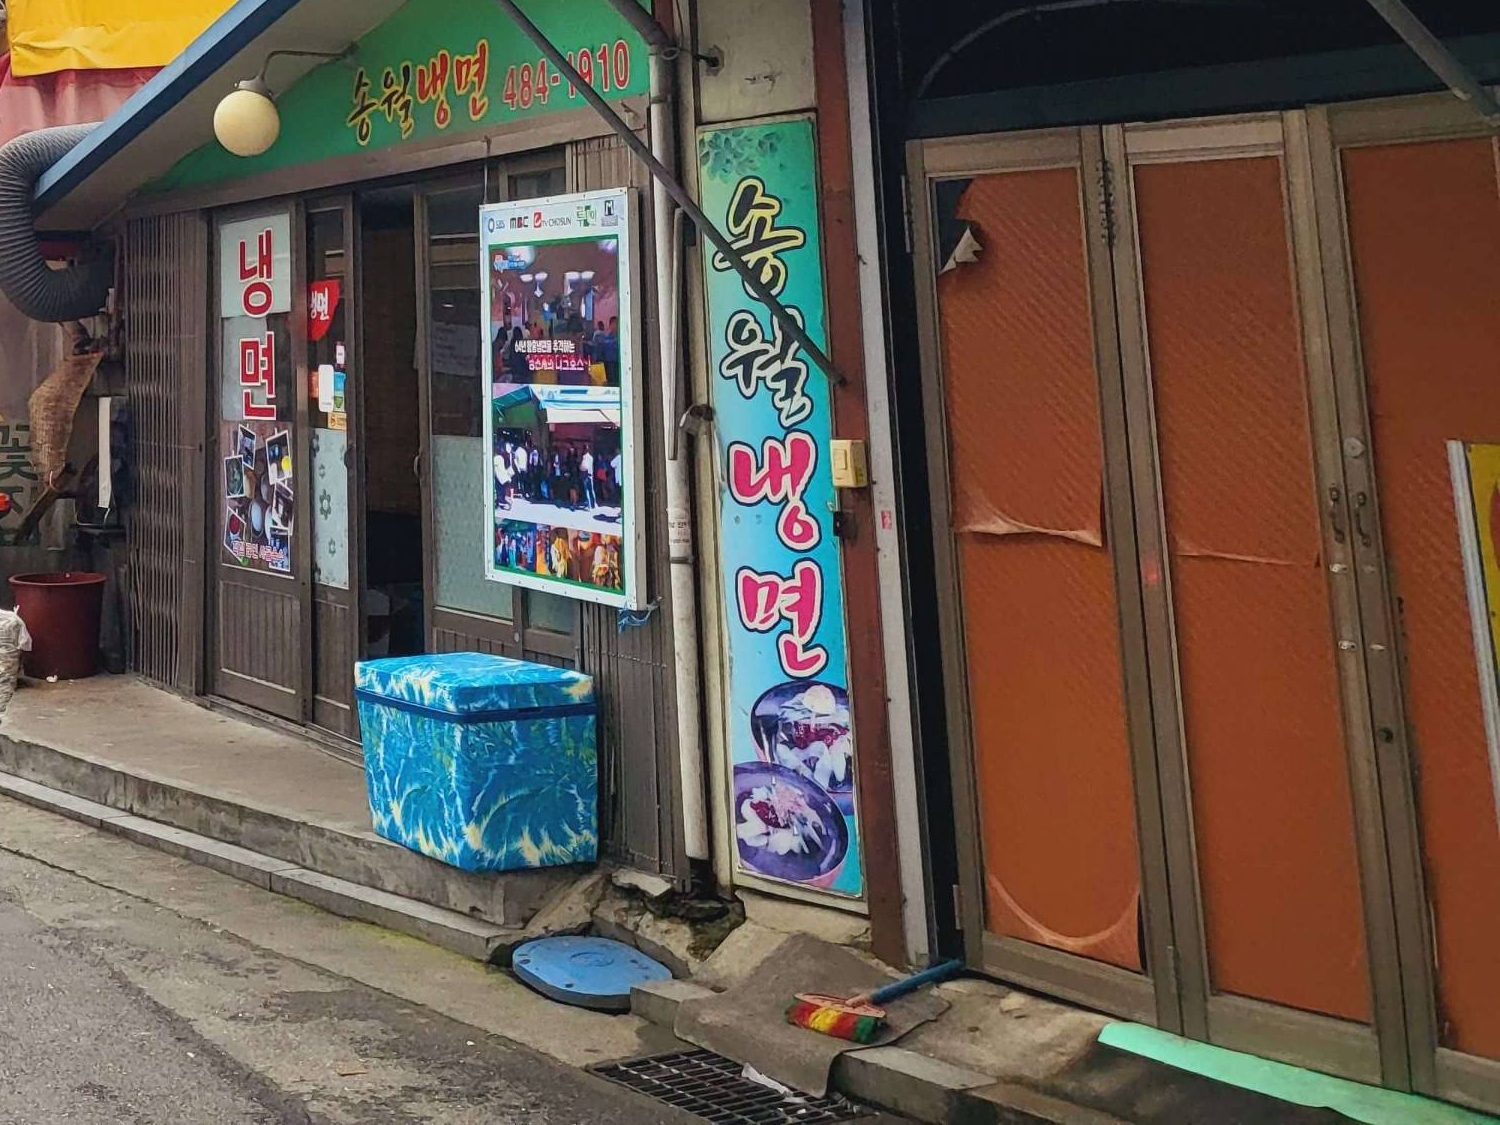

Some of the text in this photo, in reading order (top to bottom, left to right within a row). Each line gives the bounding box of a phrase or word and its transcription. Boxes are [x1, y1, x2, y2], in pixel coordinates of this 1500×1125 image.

[348, 38, 489, 146] 송월냉면
[503, 39, 630, 111] 484-1910
[509, 216, 529, 229] MBC
[238, 228, 276, 421] 냉면
[714, 178, 828, 677] 송월냉면
